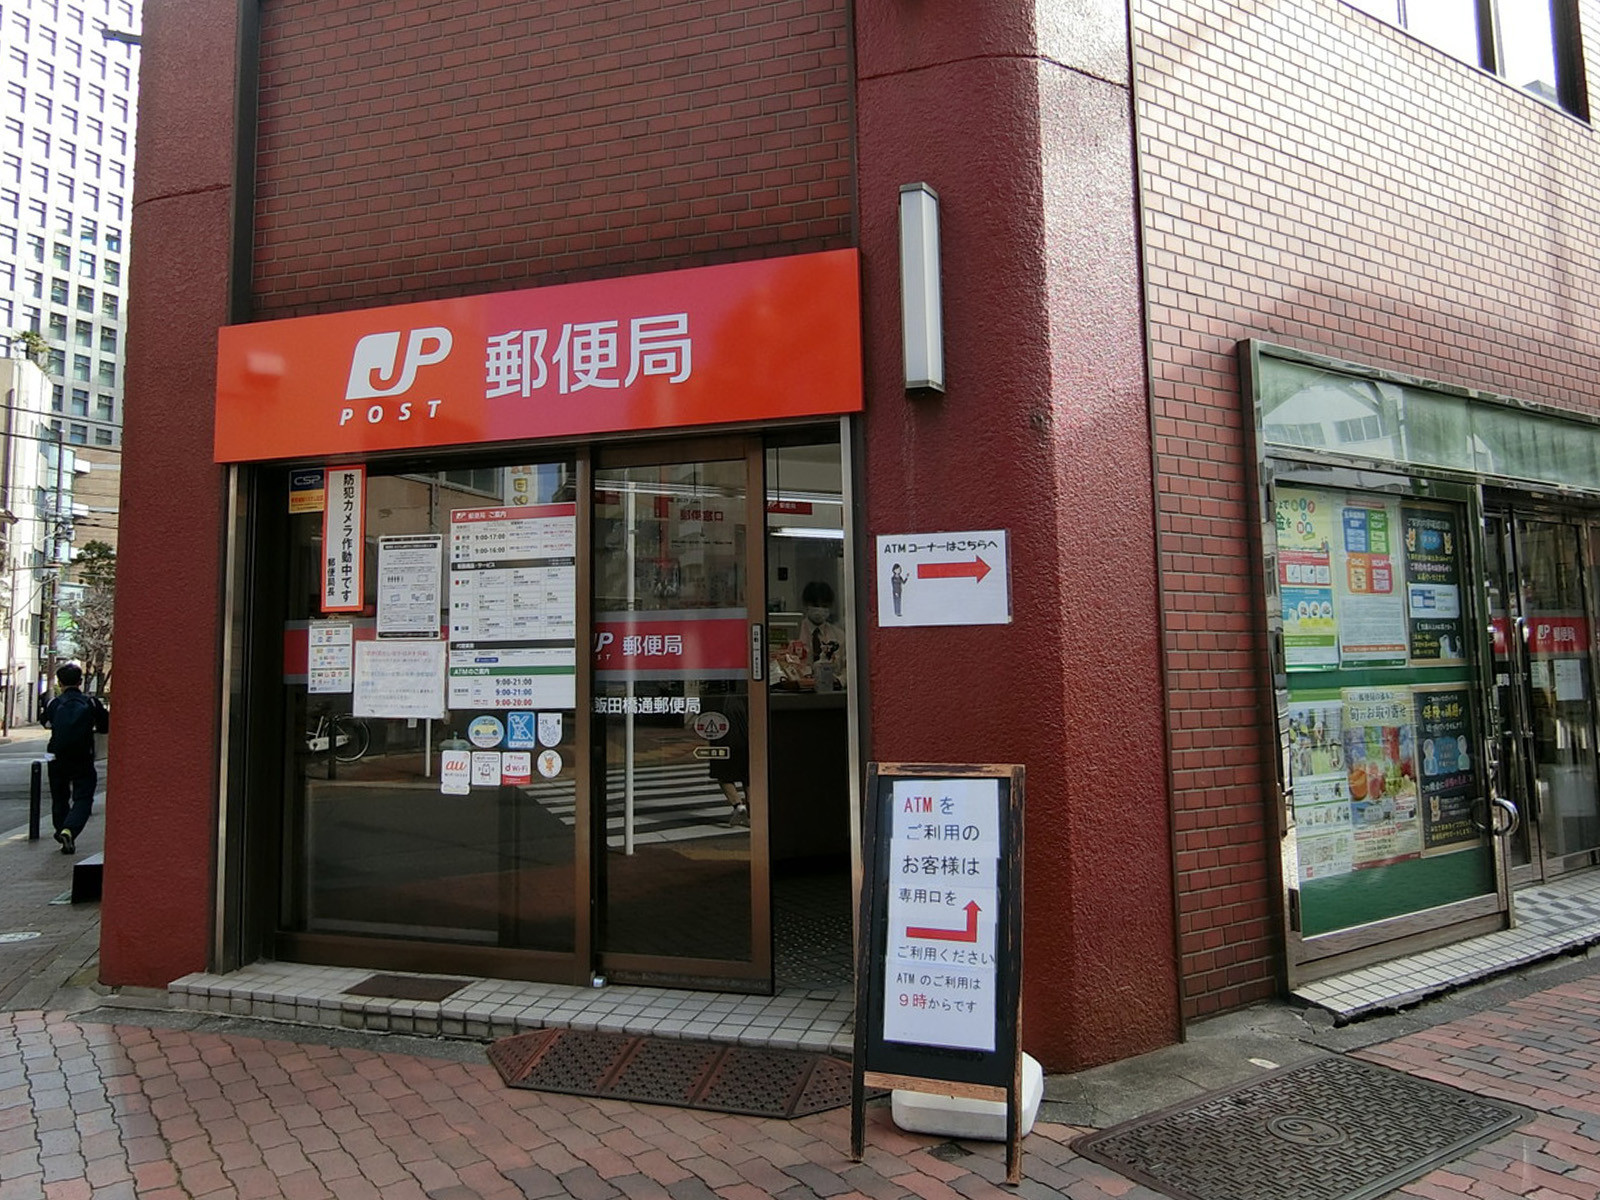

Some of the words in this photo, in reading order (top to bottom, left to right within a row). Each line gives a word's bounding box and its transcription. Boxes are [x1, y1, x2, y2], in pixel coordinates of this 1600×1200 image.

[485, 313, 692, 399] 郵便局
[339, 399, 442, 426] POST
[341, 473, 355, 602] 防犯カメラ作動中です
[884, 540, 998, 554] ATMコーナーはこちらへ
[327, 558, 336, 597] 郵便局長
[594, 632, 614, 653] P
[1553, 626, 1576, 642] 郵便局
[622, 635, 683, 656] 郵便局
[495, 678, 533, 687] 9:00-21:00
[495, 688, 533, 697] 9:00-21:00
[495, 698, 533, 707] 9:00-20:00
[445, 760, 468, 771] au
[907, 823, 980, 841] ご利用の
[902, 855, 980, 876] お客様は
[898, 887, 957, 907] 専用口を
[897, 945, 996, 965] ご利用ください
